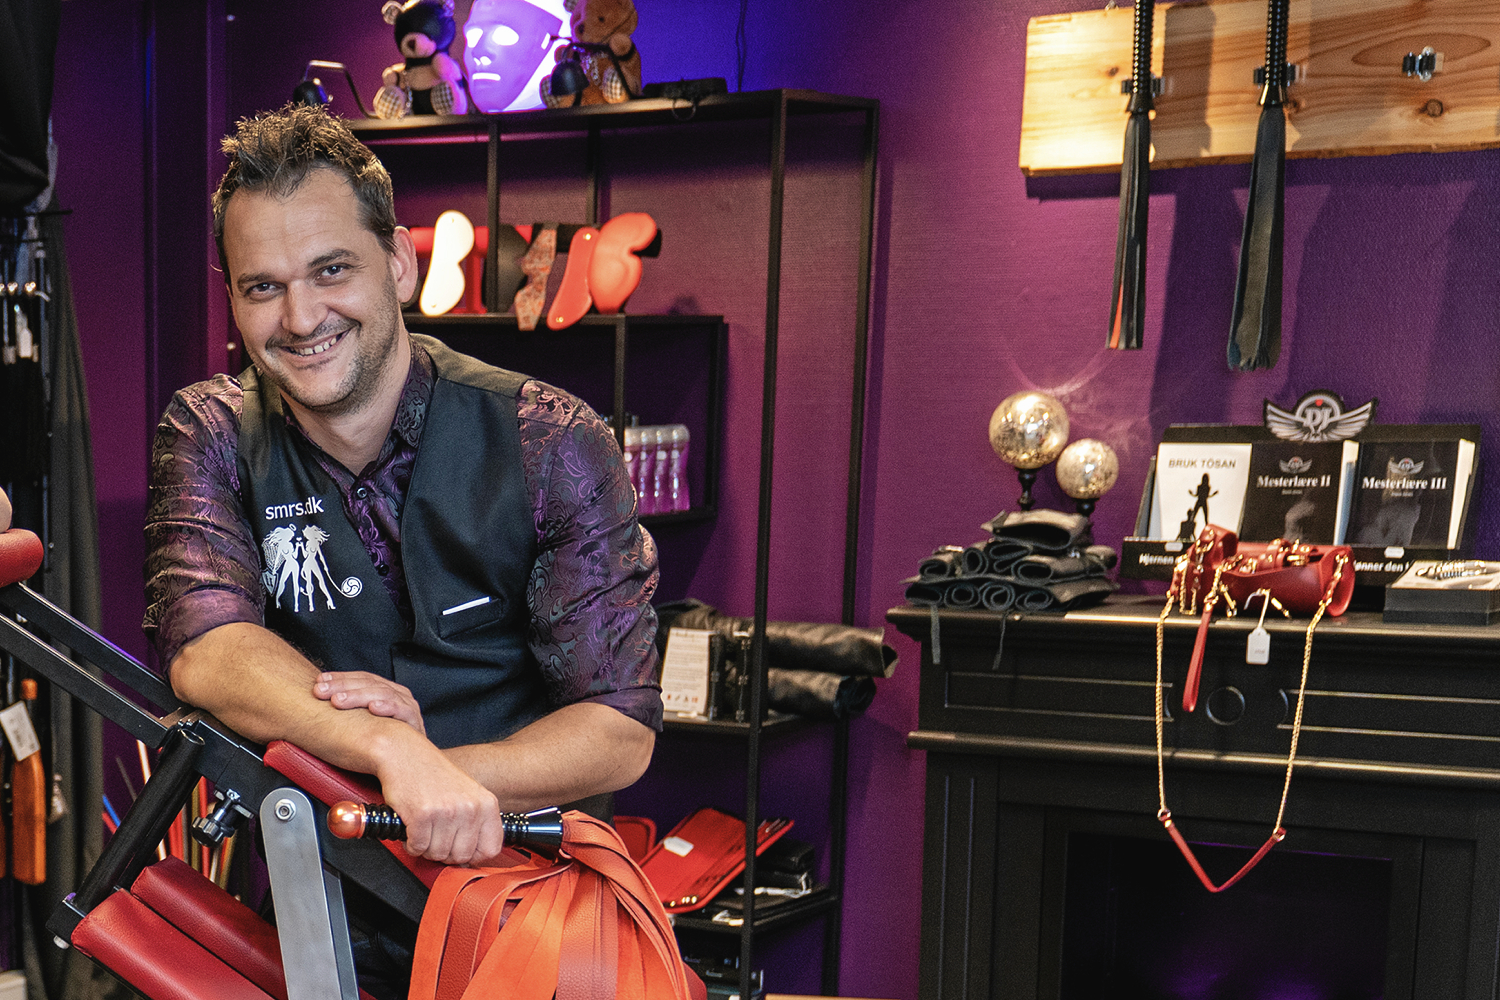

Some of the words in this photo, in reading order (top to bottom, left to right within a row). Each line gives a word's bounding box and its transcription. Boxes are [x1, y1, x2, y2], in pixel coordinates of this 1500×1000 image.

[1168, 458, 1197, 468] BRUK
[1256, 474, 1319, 488] Mesterlære
[1320, 474, 1332, 487] II
[1362, 476, 1429, 489] Mesterlære
[1430, 476, 1447, 489] III
[265, 496, 325, 520] smrs.dk
[1139, 553, 1175, 566] Hjernen
[1384, 561, 1404, 572] den
